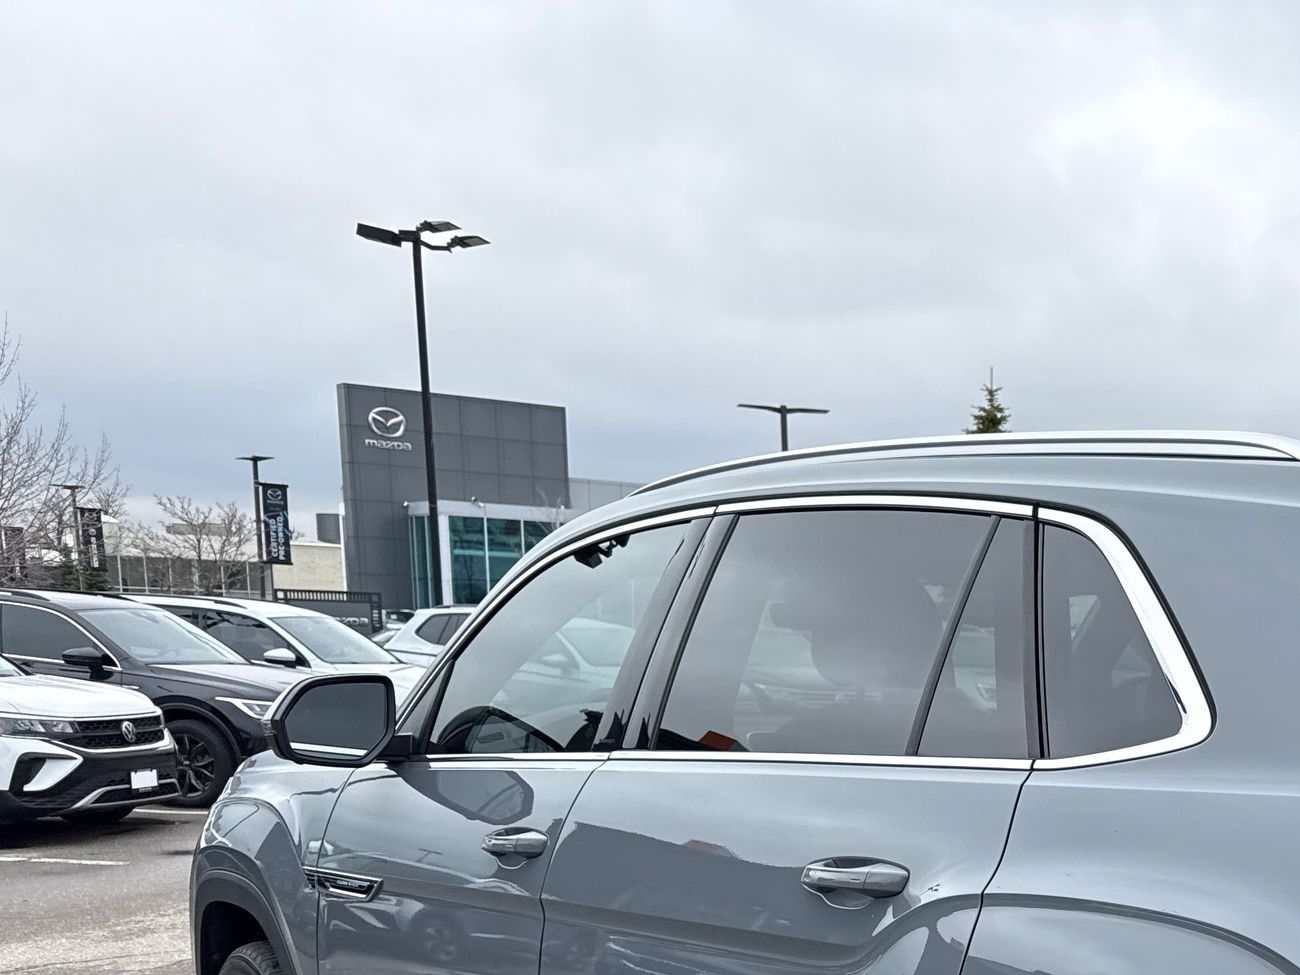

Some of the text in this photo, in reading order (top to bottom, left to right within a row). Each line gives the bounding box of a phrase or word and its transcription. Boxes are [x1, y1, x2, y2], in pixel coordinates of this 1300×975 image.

[365, 439, 412, 450] mazda
[269, 518, 278, 557] CERTIFIED
[335, 617, 369, 626] zda
